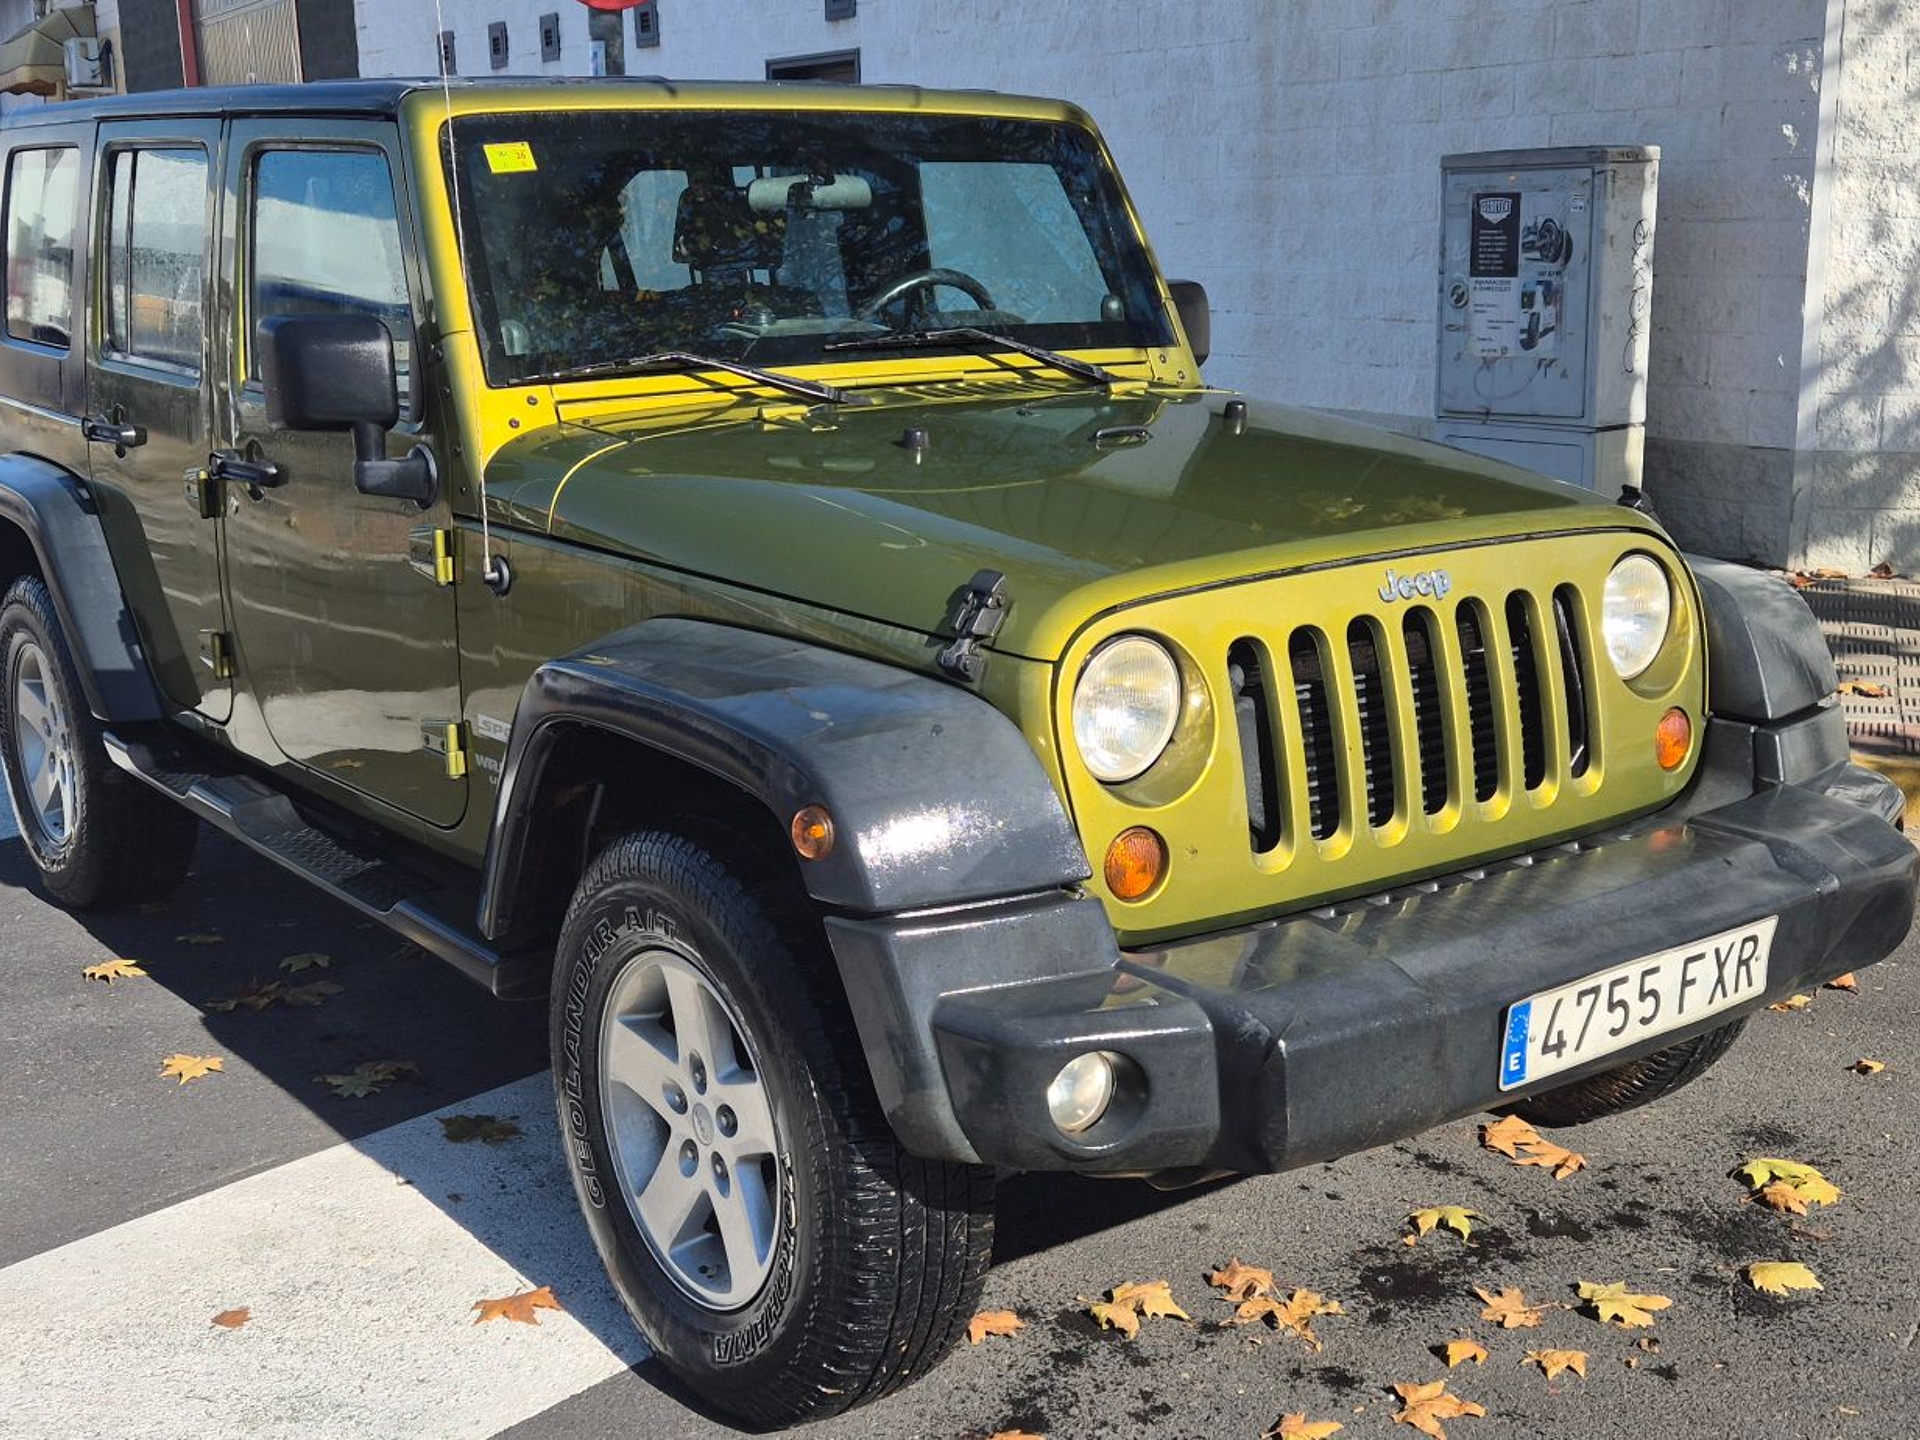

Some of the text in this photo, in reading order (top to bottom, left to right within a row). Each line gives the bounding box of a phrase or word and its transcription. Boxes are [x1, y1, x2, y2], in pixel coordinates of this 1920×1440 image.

[1378, 568, 1451, 603] Jeep
[1541, 934, 1760, 1059] 4755 FXR
[564, 917, 619, 1209] GEOLANDAR
[1508, 1052, 1521, 1072] E
